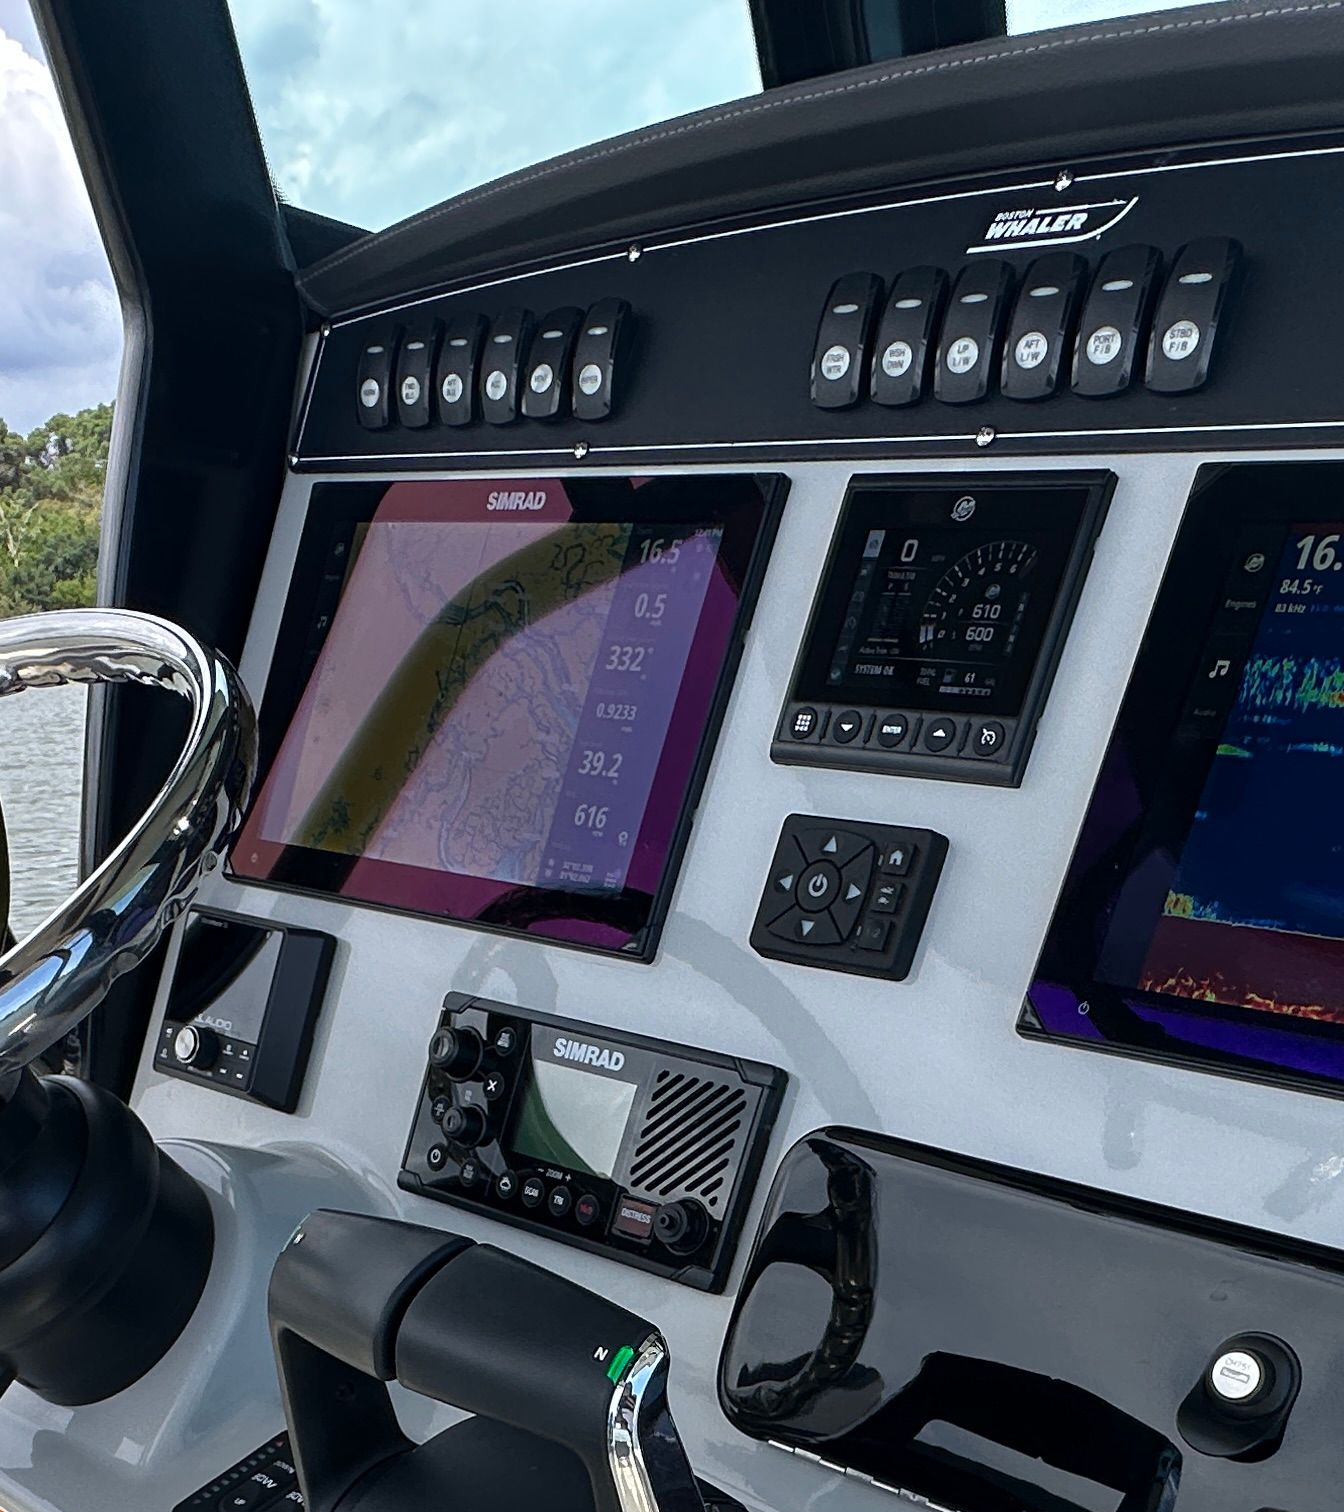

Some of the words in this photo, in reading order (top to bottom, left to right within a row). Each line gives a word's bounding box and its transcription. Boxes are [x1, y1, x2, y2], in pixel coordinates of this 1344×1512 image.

[994, 208, 1034, 222] BOSTON
[985, 213, 1088, 240] WHALER
[1093, 334, 1115, 344] PORT
[1169, 328, 1192, 339] STBD
[1024, 340, 1040, 349] AFT
[487, 492, 546, 510] SIMRAD
[640, 539, 683, 564] 16.5
[900, 539, 919, 562] 0
[1280, 579, 1313, 594] 84.5
[635, 593, 667, 618] 0.5
[972, 604, 1001, 618] 610
[965, 626, 994, 641] 600
[596, 703, 637, 721] 0.9233
[578, 750, 623, 778] 39.2
[574, 804, 608, 828] 616
[553, 1038, 625, 1072] SIMRAD
[594, 1346, 608, 1361] N
